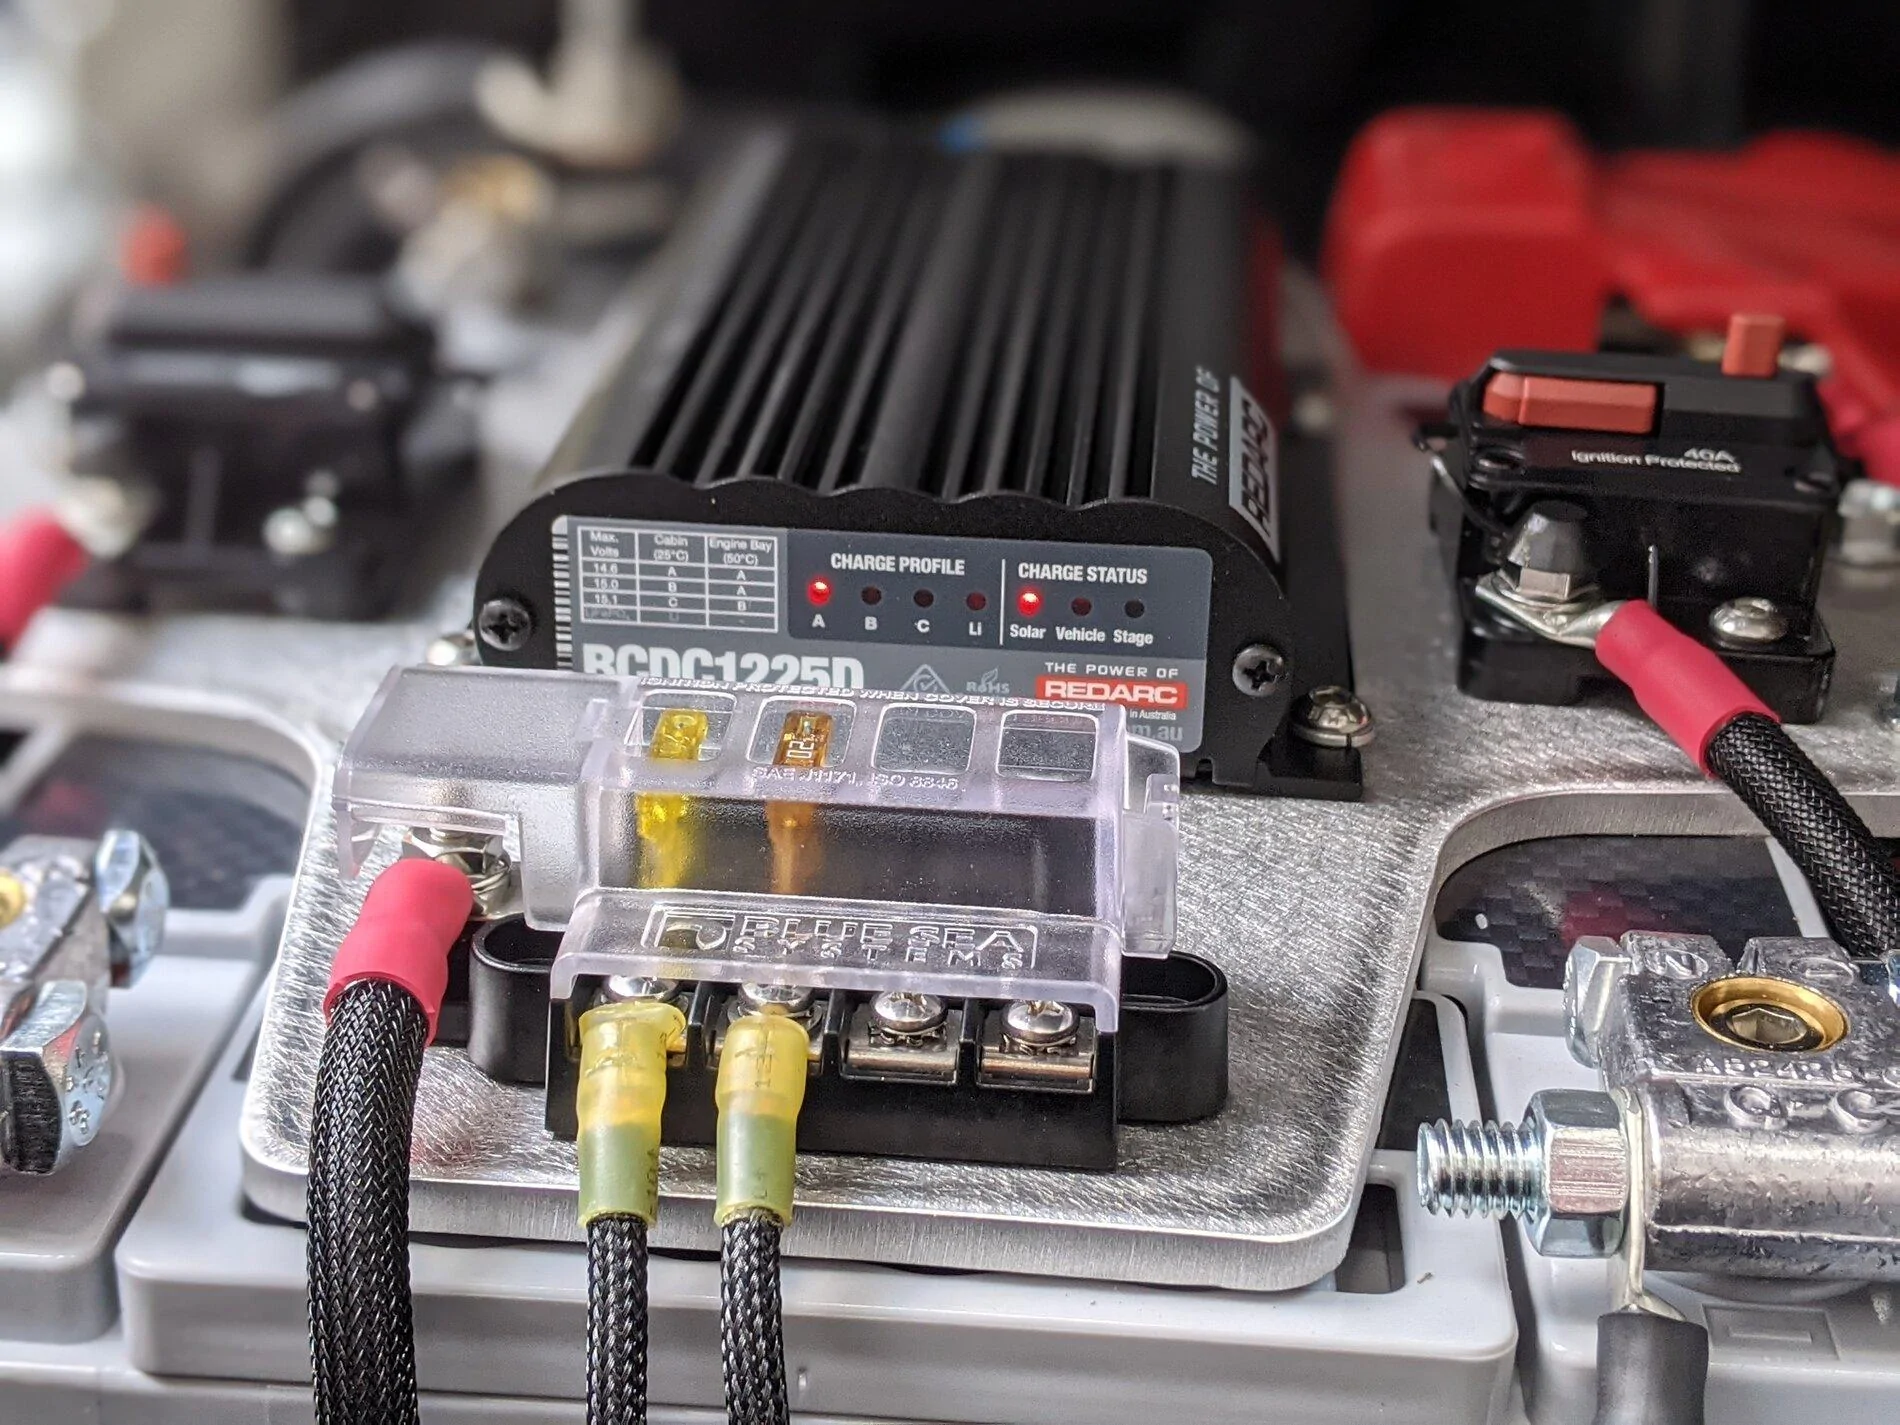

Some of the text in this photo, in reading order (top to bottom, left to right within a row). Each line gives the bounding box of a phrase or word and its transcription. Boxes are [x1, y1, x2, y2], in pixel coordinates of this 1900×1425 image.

[1191, 365, 1220, 485] THE POWER OF
[1572, 450, 1741, 473] Ignition Protected
[1684, 448, 1735, 463] 40A
[590, 531, 619, 544] Max.
[654, 534, 688, 547] Cabin
[590, 545, 619, 558] Volts
[709, 538, 772, 553] Engine Bay
[668, 566, 677, 577] A
[830, 553, 965, 576] CHARGE PROFILE
[737, 570, 746, 581] A
[1018, 562, 1148, 585] CHARGE STATUS
[668, 582, 677, 592] B
[737, 585, 746, 596] A
[668, 597, 678, 608] C
[738, 601, 747, 611] B
[812, 614, 826, 628] A
[864, 616, 878, 631] B
[916, 619, 930, 633] C
[1010, 624, 1046, 639] Solar
[1055, 626, 1106, 642] Vehicle
[1113, 629, 1154, 648] Stage
[1045, 662, 1179, 679] THE POWER OF
[1044, 680, 1178, 705] REDARC
[1140, 709, 1176, 720] Australia
[907, 924, 1024, 954] SEA
